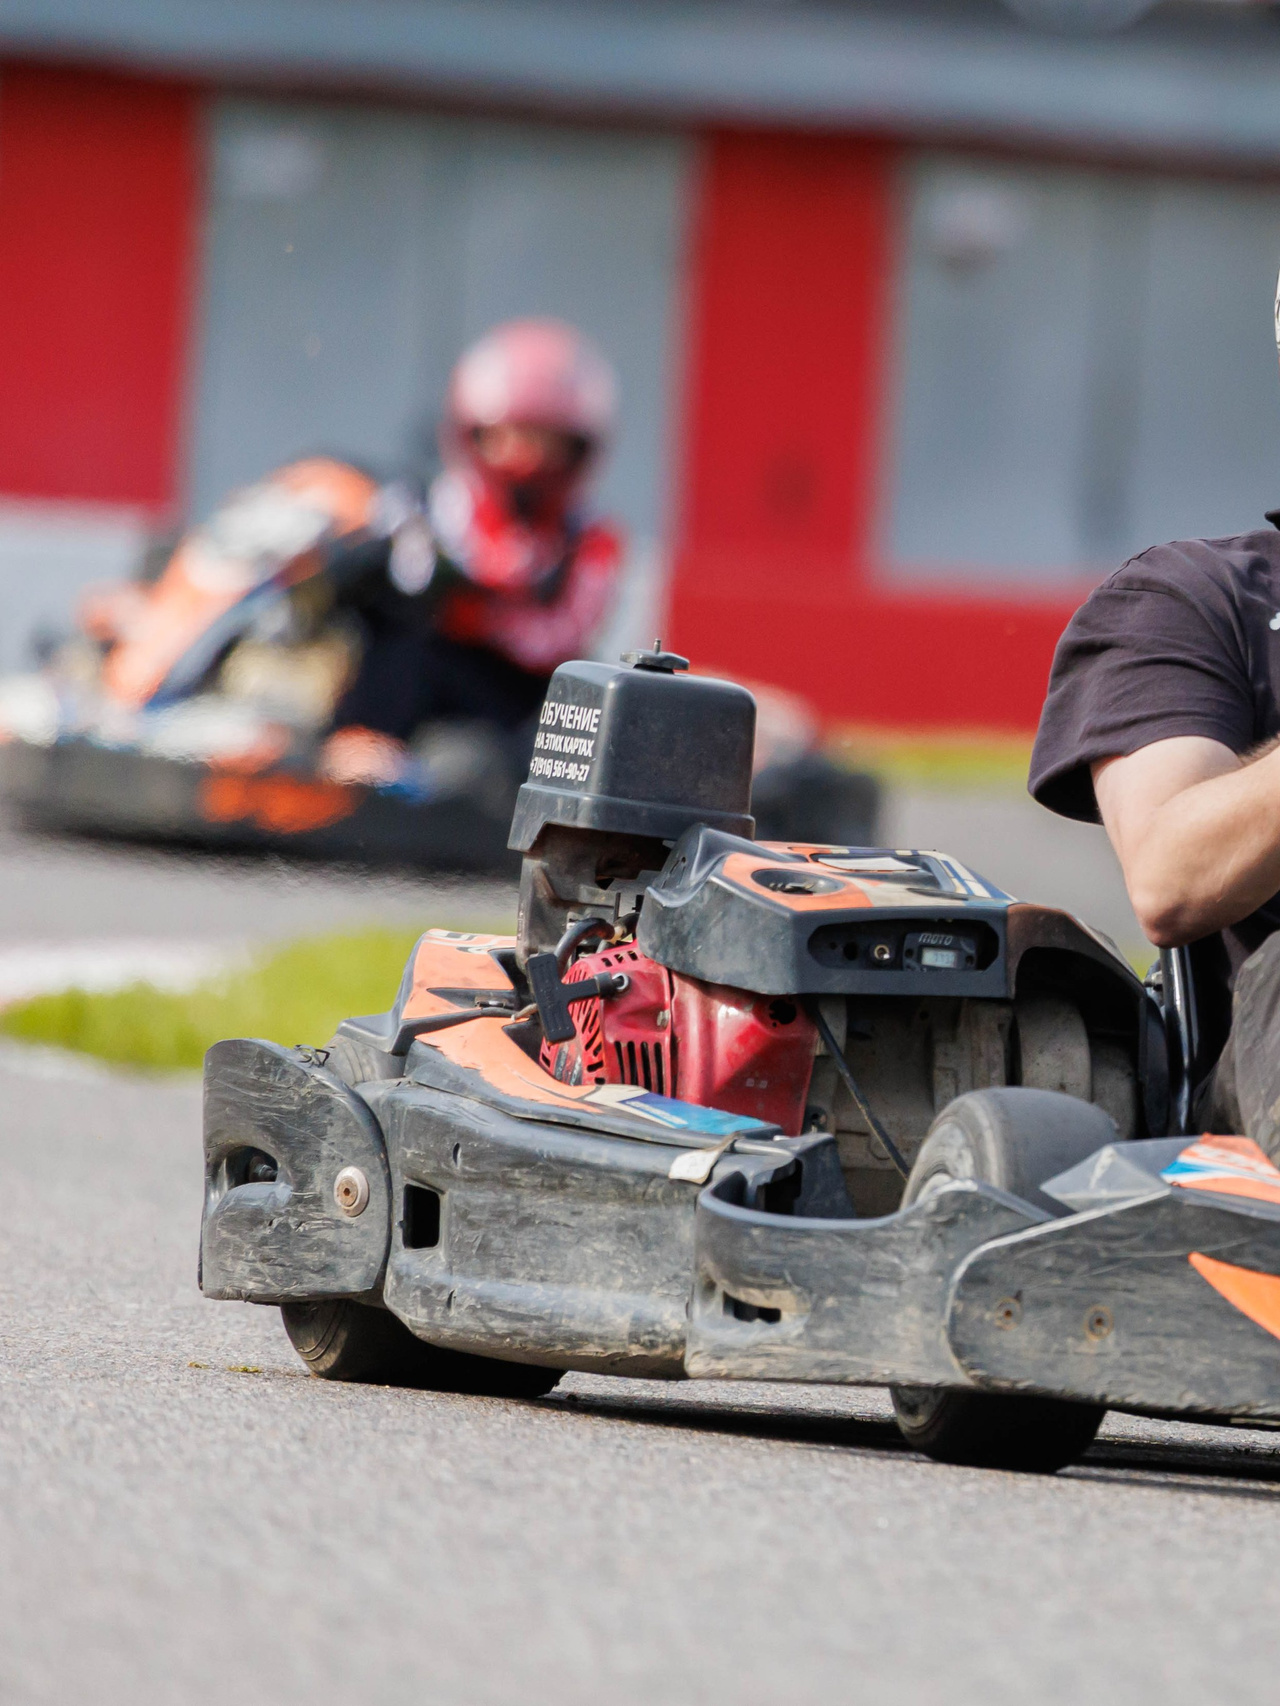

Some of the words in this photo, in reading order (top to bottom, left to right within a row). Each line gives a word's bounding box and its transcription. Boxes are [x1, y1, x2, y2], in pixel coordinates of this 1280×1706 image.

[540, 701, 602, 733] ОБУЧЕНИЕ
[534, 732, 546, 749] НА
[543, 732, 565, 752] ЭТИХ
[562, 736, 595, 757] КАРТАХ
[551, 760, 590, 782] 561-90-27
